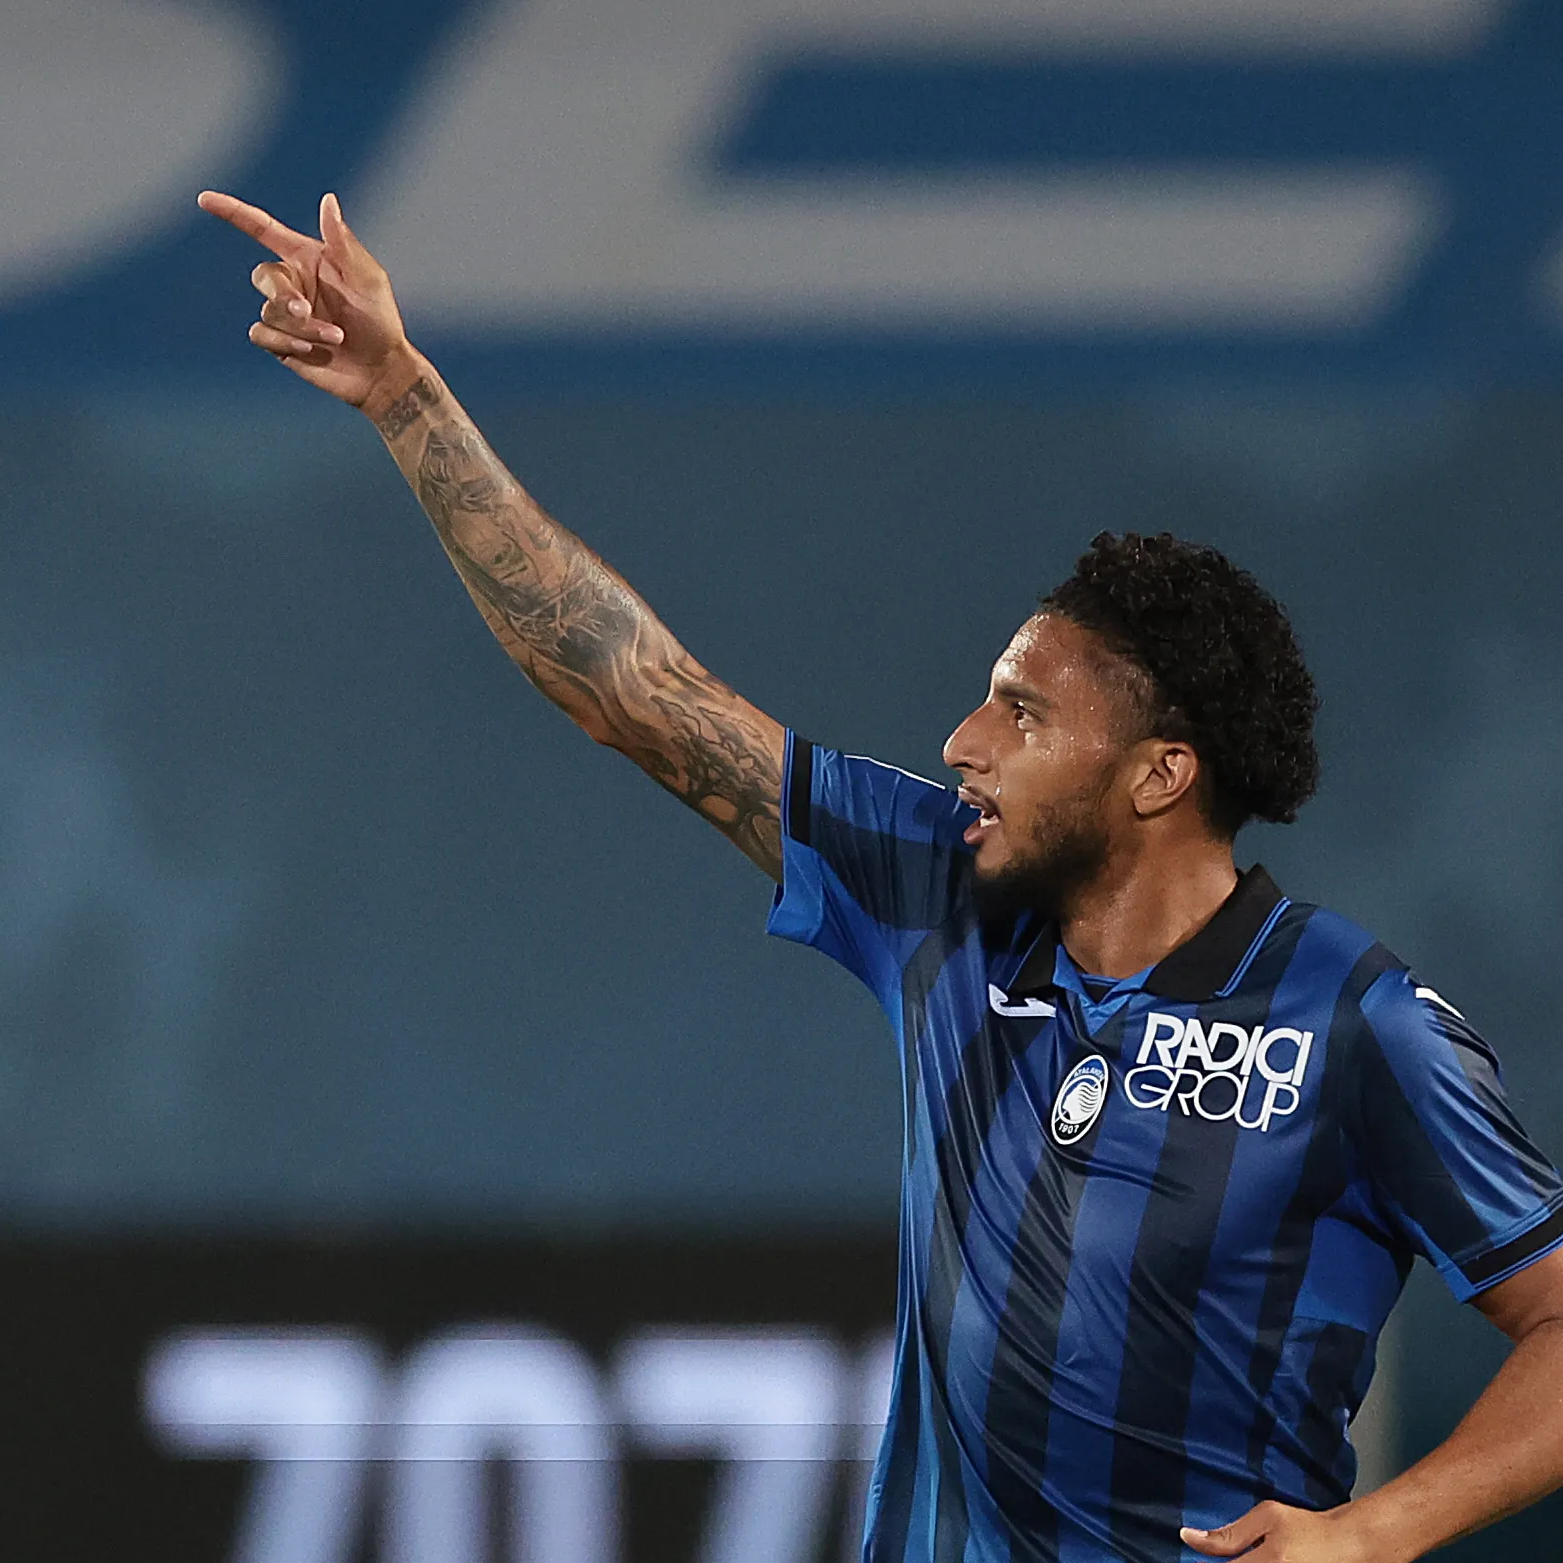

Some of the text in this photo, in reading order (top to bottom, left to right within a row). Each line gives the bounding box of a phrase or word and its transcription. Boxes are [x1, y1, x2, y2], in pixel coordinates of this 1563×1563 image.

[1136, 1011, 1314, 1087] RADICI
[1058, 1122, 1080, 1135] 1907
[1124, 1064, 1300, 1133] GROUP
